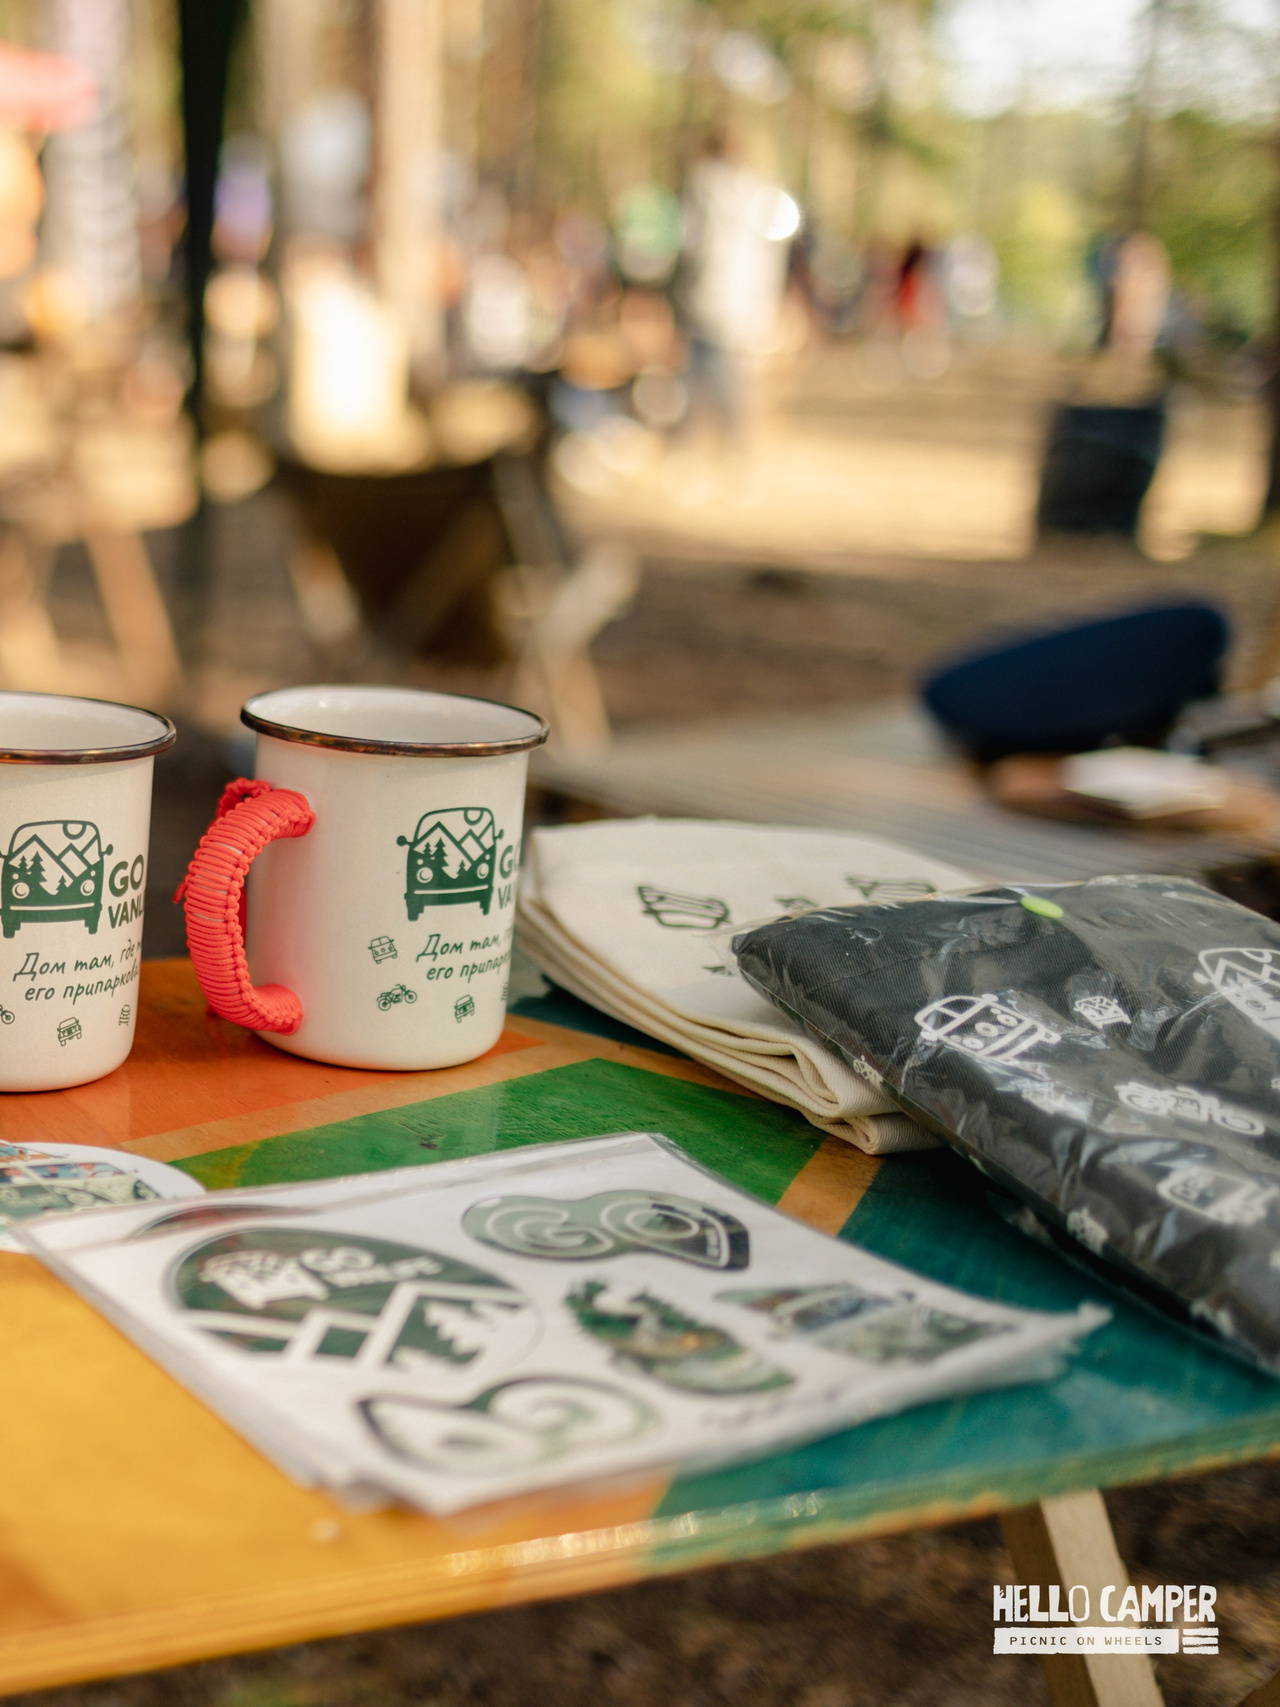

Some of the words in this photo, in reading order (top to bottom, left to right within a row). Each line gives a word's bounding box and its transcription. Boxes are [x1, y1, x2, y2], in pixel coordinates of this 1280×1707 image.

[108, 854, 144, 898] GO
[12, 952, 66, 982] Дом
[74, 954, 115, 971] там,
[119, 938, 136, 963] где
[415, 933, 463, 963] Дом
[426, 966, 454, 981] его
[24, 986, 56, 1001] его
